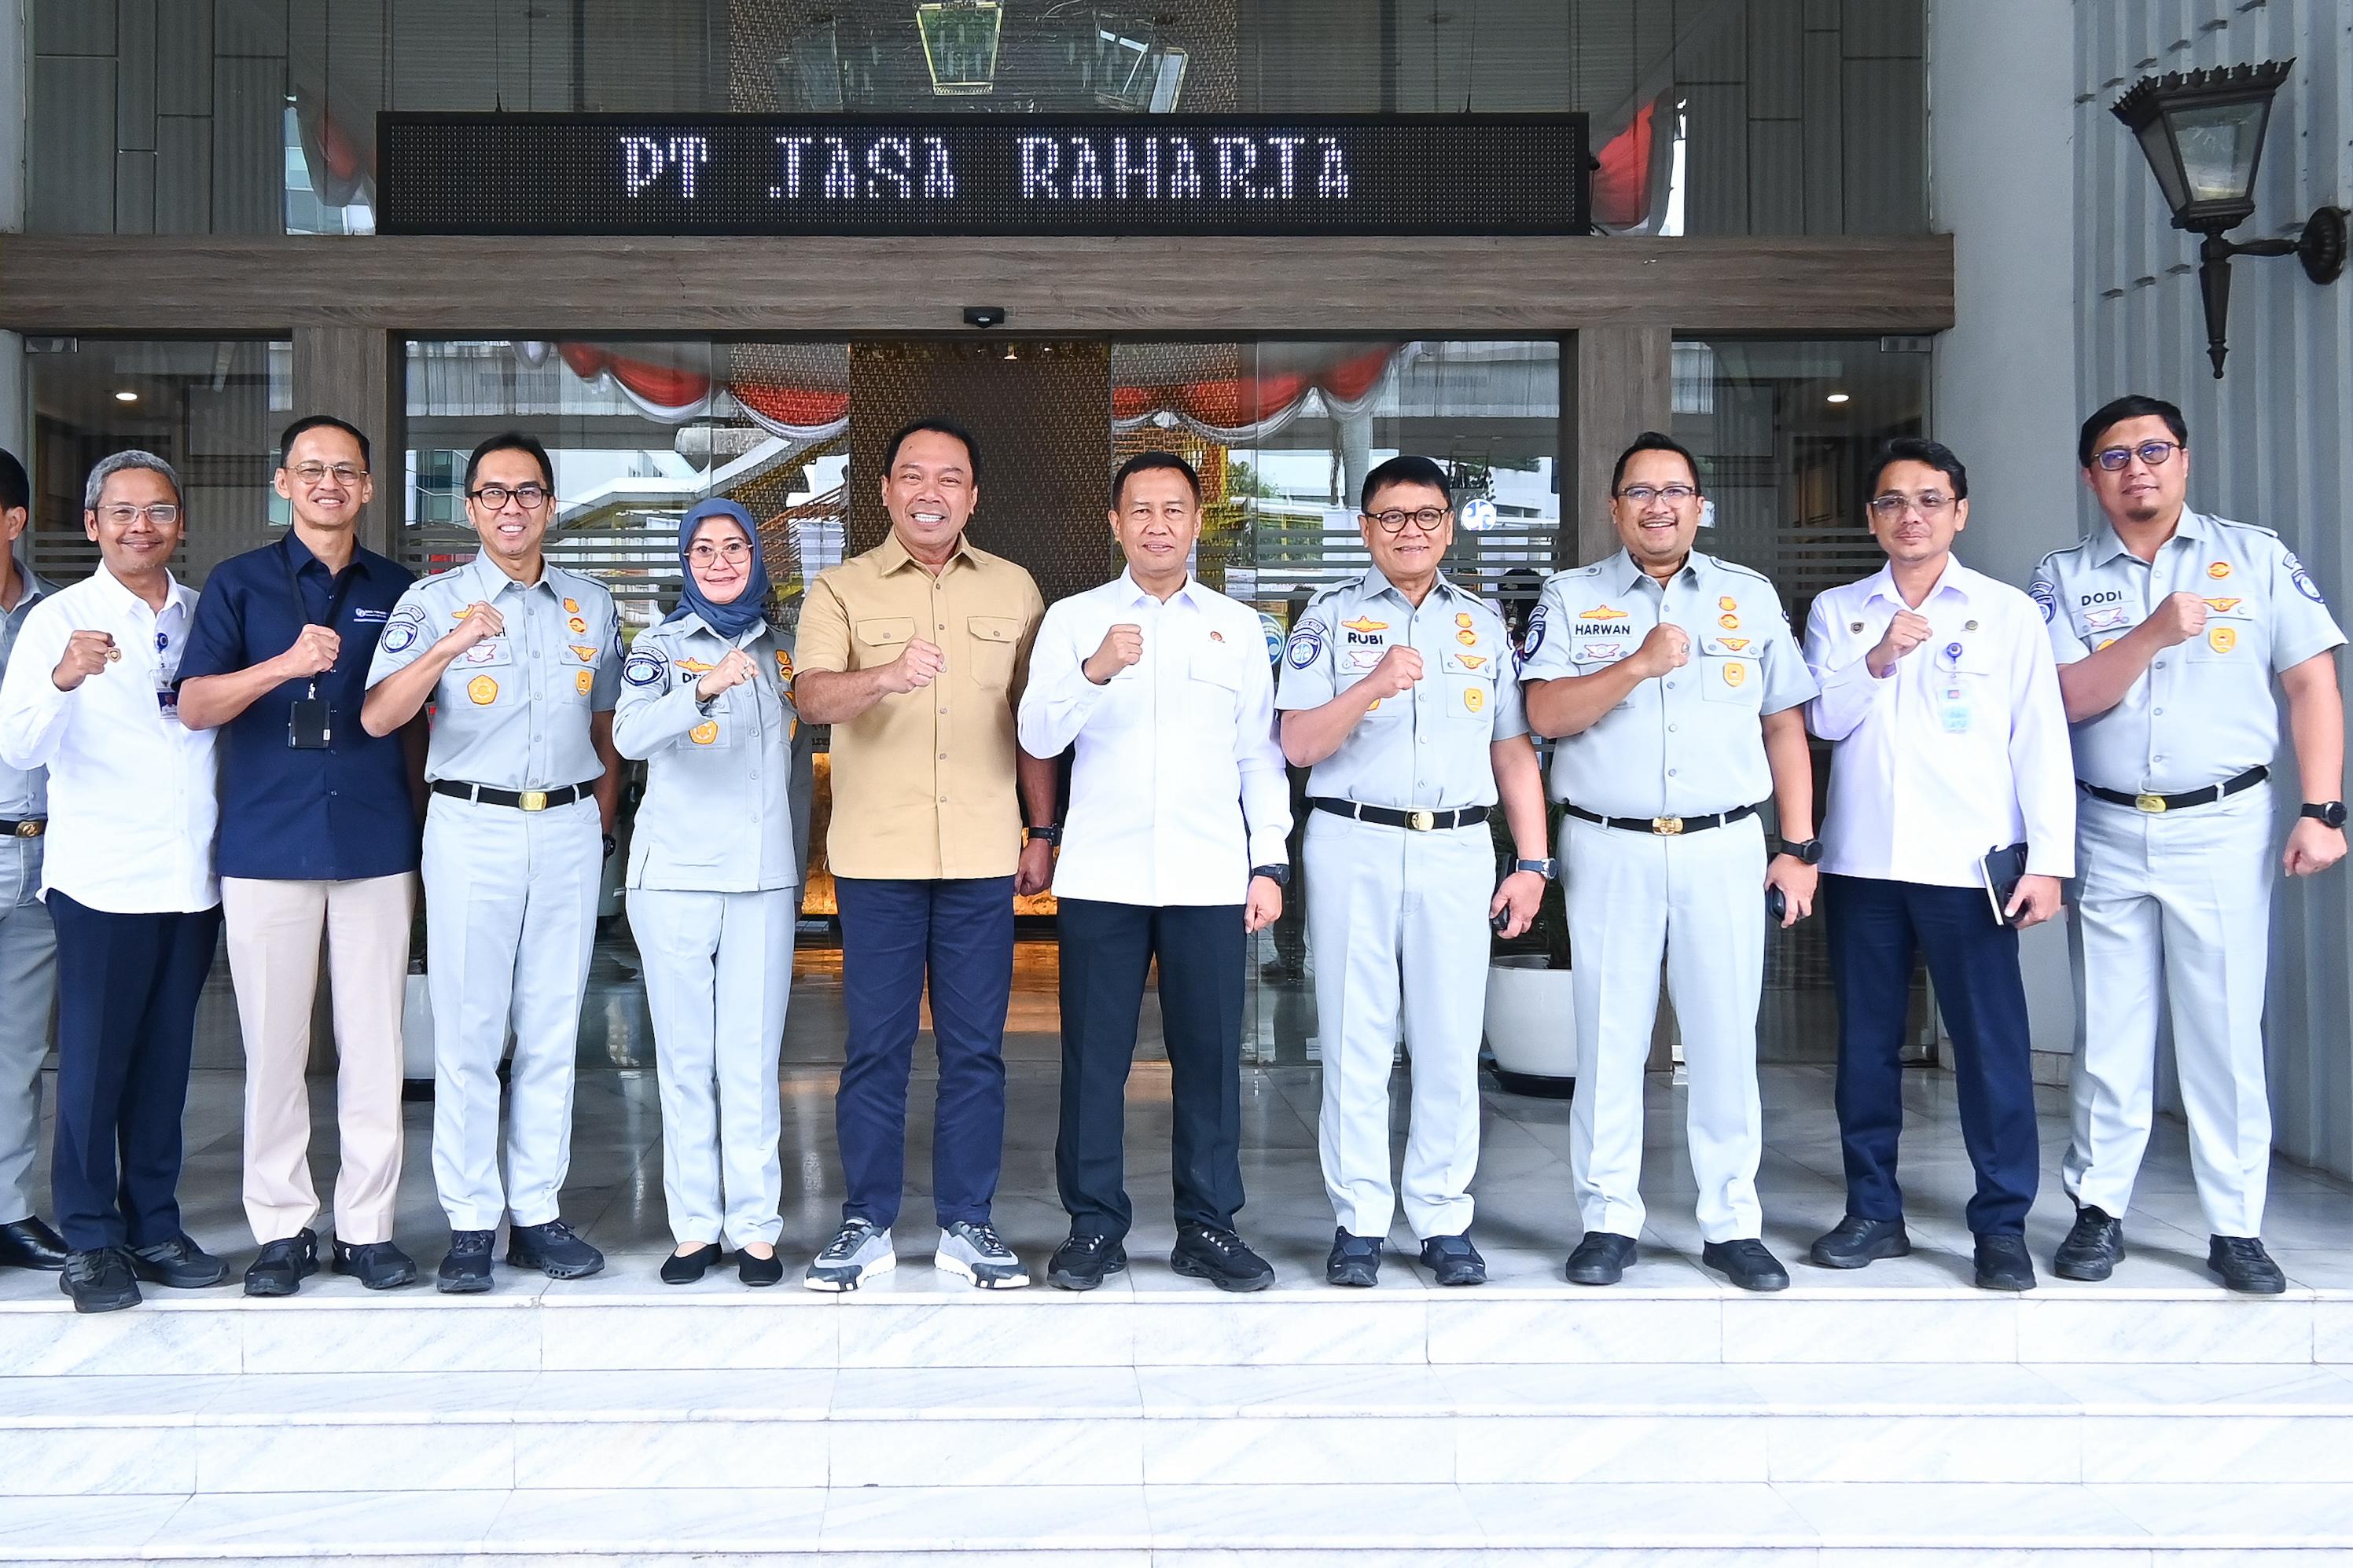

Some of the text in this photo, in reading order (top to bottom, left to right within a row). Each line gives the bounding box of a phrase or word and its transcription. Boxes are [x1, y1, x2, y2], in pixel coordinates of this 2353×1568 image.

[620, 137, 1349, 199] PT JASA RAHARJA
[2081, 590, 2122, 606] DODI
[1575, 624, 1631, 635] HARWAN
[1347, 632, 1383, 644] RUBI
